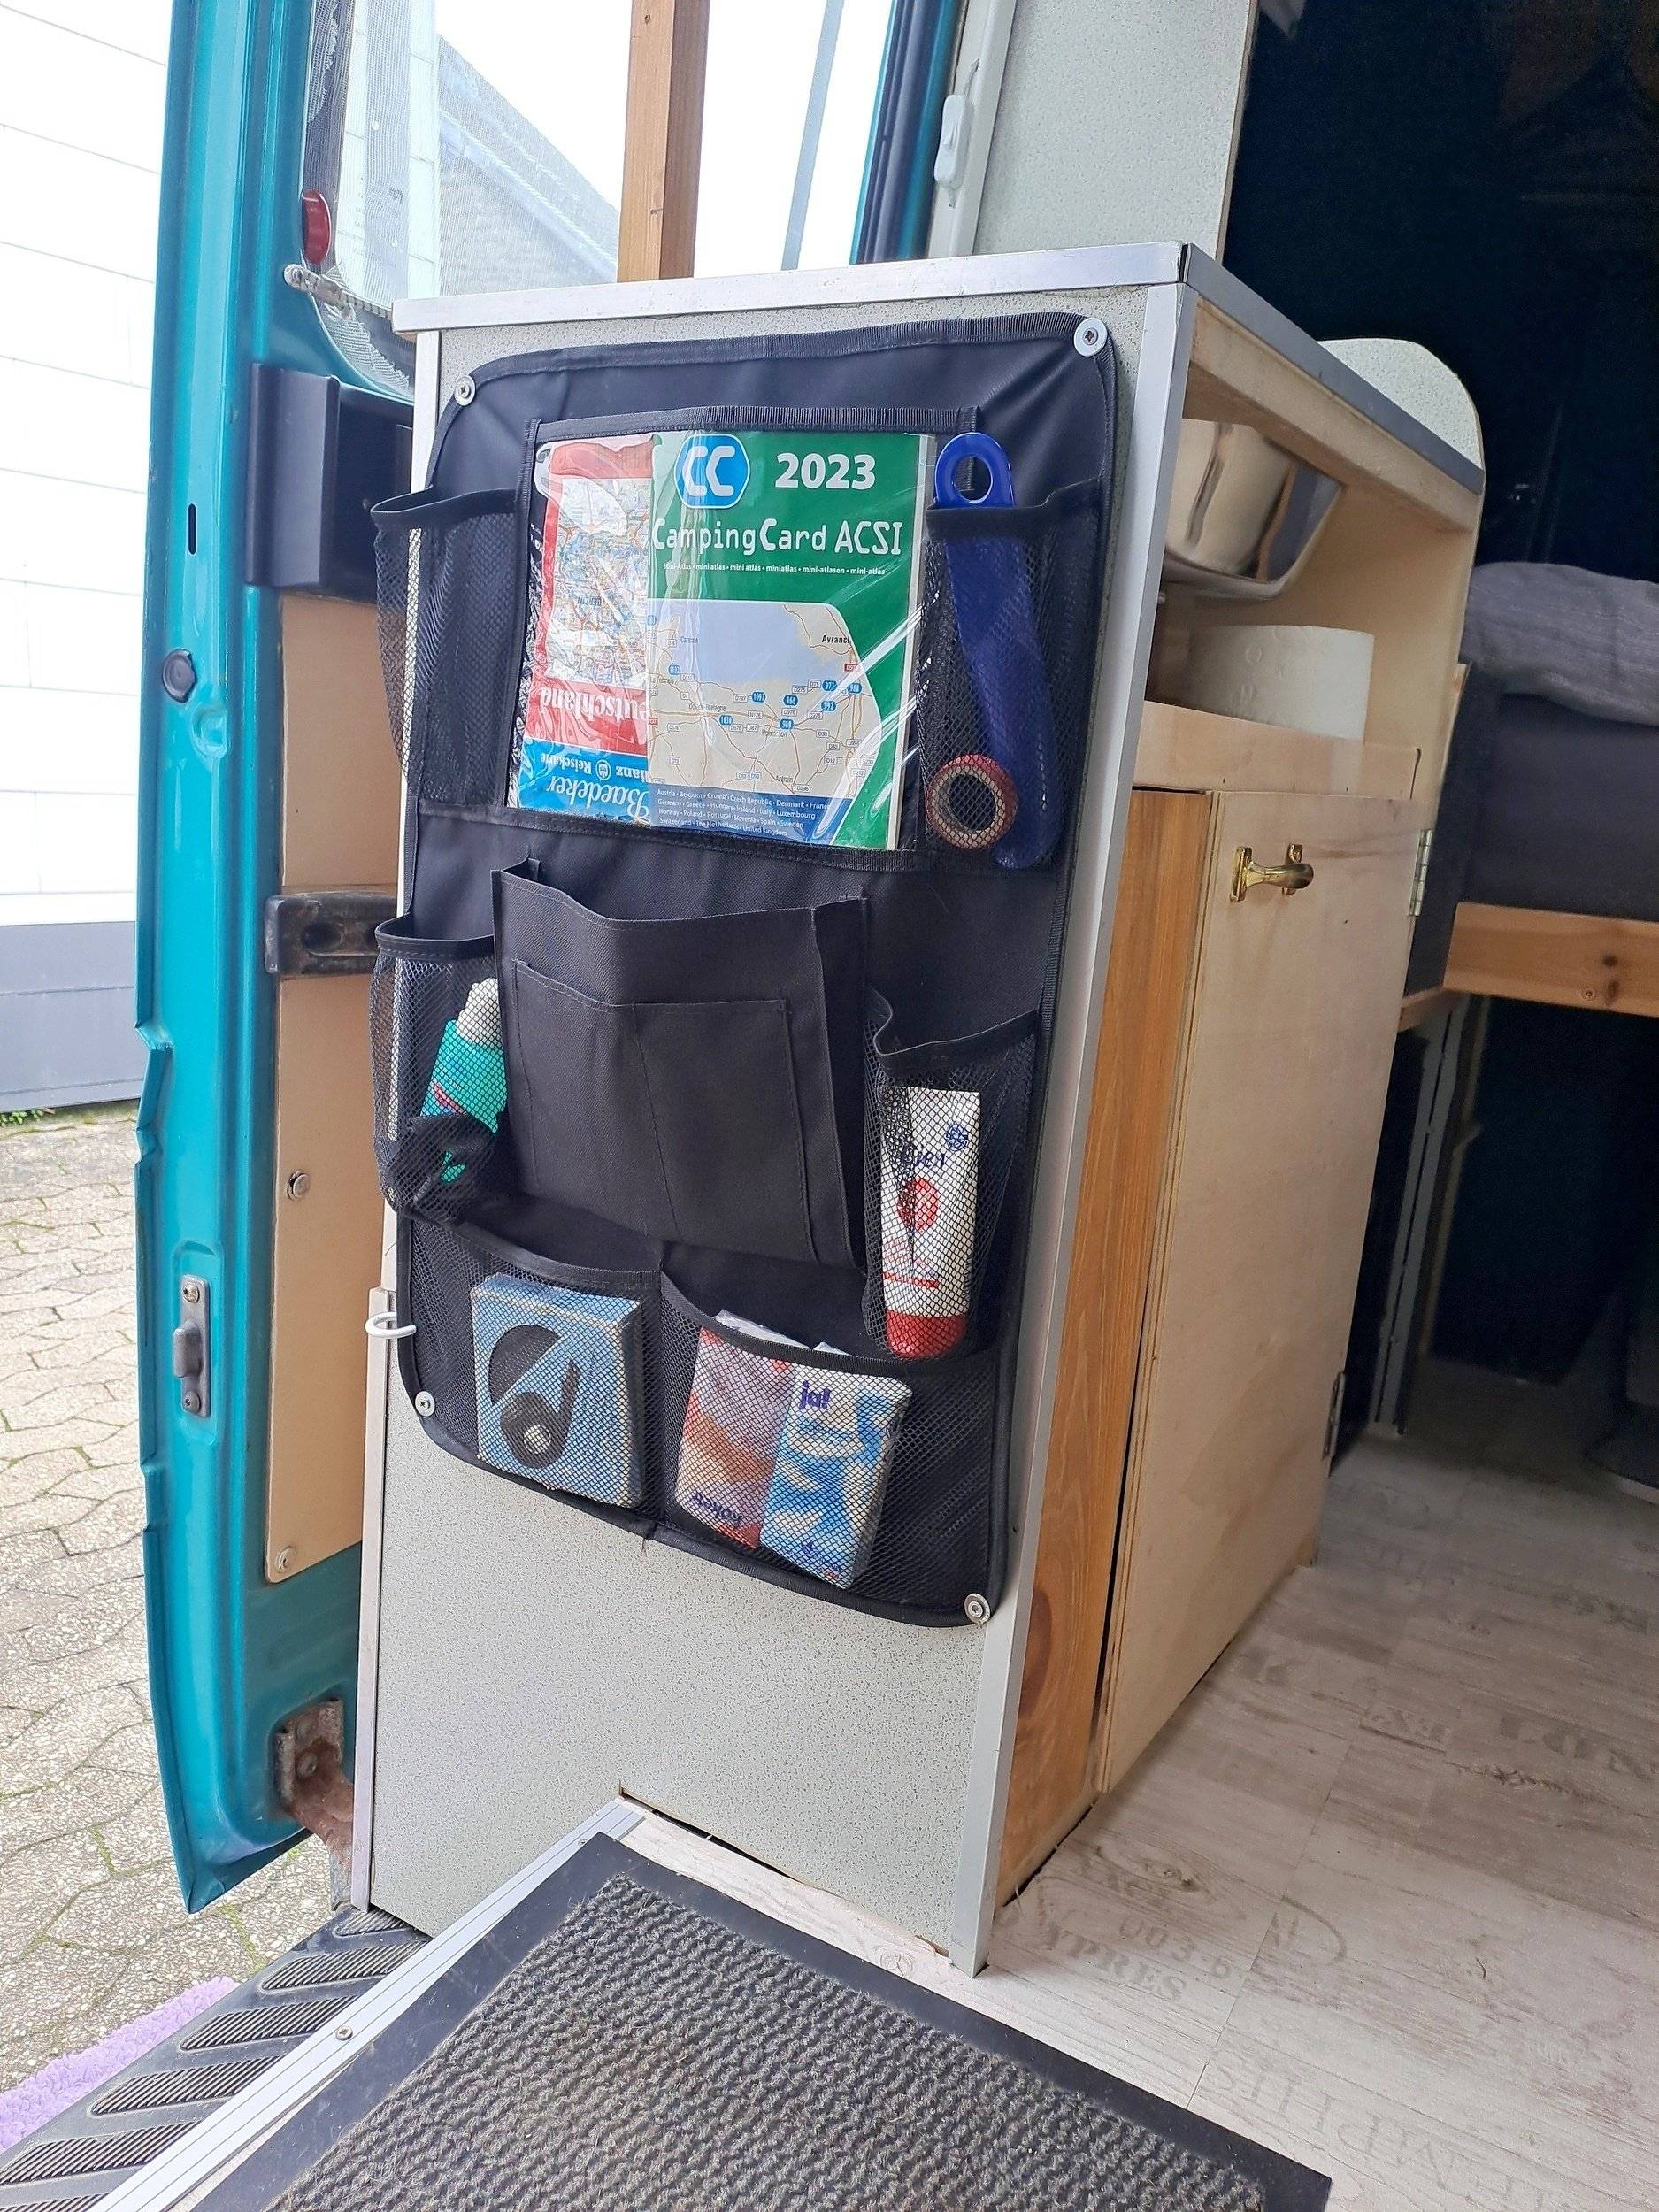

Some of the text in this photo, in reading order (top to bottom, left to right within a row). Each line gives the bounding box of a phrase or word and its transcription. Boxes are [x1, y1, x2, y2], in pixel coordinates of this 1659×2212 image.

[681, 445, 736, 497] CC
[774, 452, 877, 490] 2023
[833, 520, 902, 555] ACSI
[540, 753, 592, 774] Reisekarte
[545, 776, 649, 818] Baedeker
[747, 797, 772, 806] Republic
[776, 800, 805, 809] Denmark
[736, 805, 756, 814] Ireland
[776, 810, 816, 820] Luxembourg
[760, 818, 776, 826] Spain
[780, 820, 804, 829] Sweden
[798, 1380, 832, 1410] ja!
